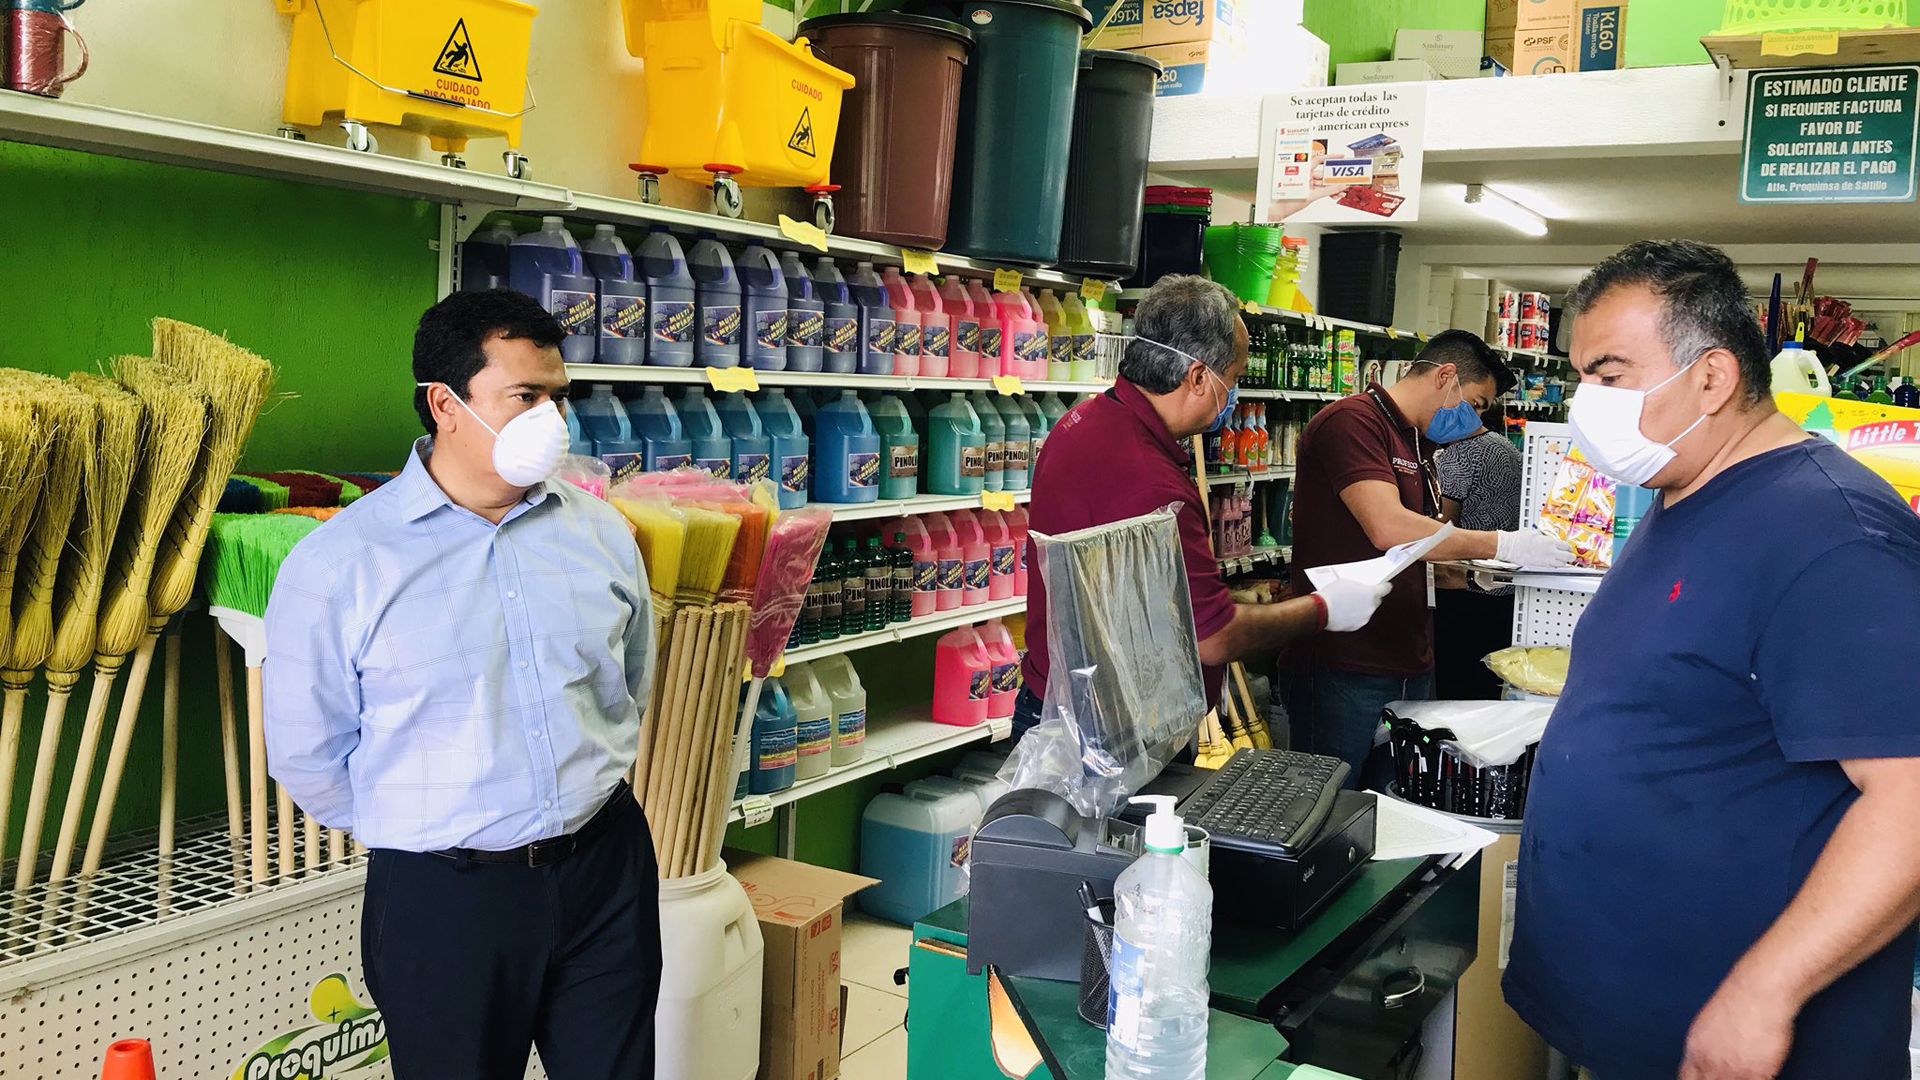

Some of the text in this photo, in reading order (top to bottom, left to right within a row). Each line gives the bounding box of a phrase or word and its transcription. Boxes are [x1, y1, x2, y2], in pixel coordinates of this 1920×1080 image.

[1599, 11, 1615, 50] K160
[436, 79, 479, 96] CUIDADO
[792, 79, 822, 101] CUIDADO
[1764, 75, 1908, 96] ESTIMADO CLIENTE
[1291, 91, 1397, 109] Se aceptan todas las
[1296, 105, 1390, 121] tarjetas de crédito
[1765, 99, 1902, 117] SI REQUIERE FACTURA
[1318, 121, 1409, 134] american express
[1800, 121, 1862, 136] FAVOR DE
[1768, 140, 1893, 156] SOLICITARLA ANTES
[1331, 166, 1365, 176] VISA
[1761, 161, 1896, 176] DE REALIZAR EL PAGO
[1767, 181, 1887, 192] Atte. Proquimsa de Saltillo
[569, 300, 590, 314] MULTI
[618, 304, 638, 317] MULTI
[669, 309, 689, 323] MULTI
[719, 312, 737, 327] MULTI
[770, 316, 786, 331] MULTI
[800, 316, 817, 329] MULTI
[836, 323, 851, 336] MULTI
[1850, 423, 1906, 448] Little
[617, 460, 636, 476] MULTI
[710, 465, 726, 476] ULTI
[750, 460, 766, 474] MULTI
[793, 461, 806, 474] MULTI
[861, 458, 875, 471] MULTI
